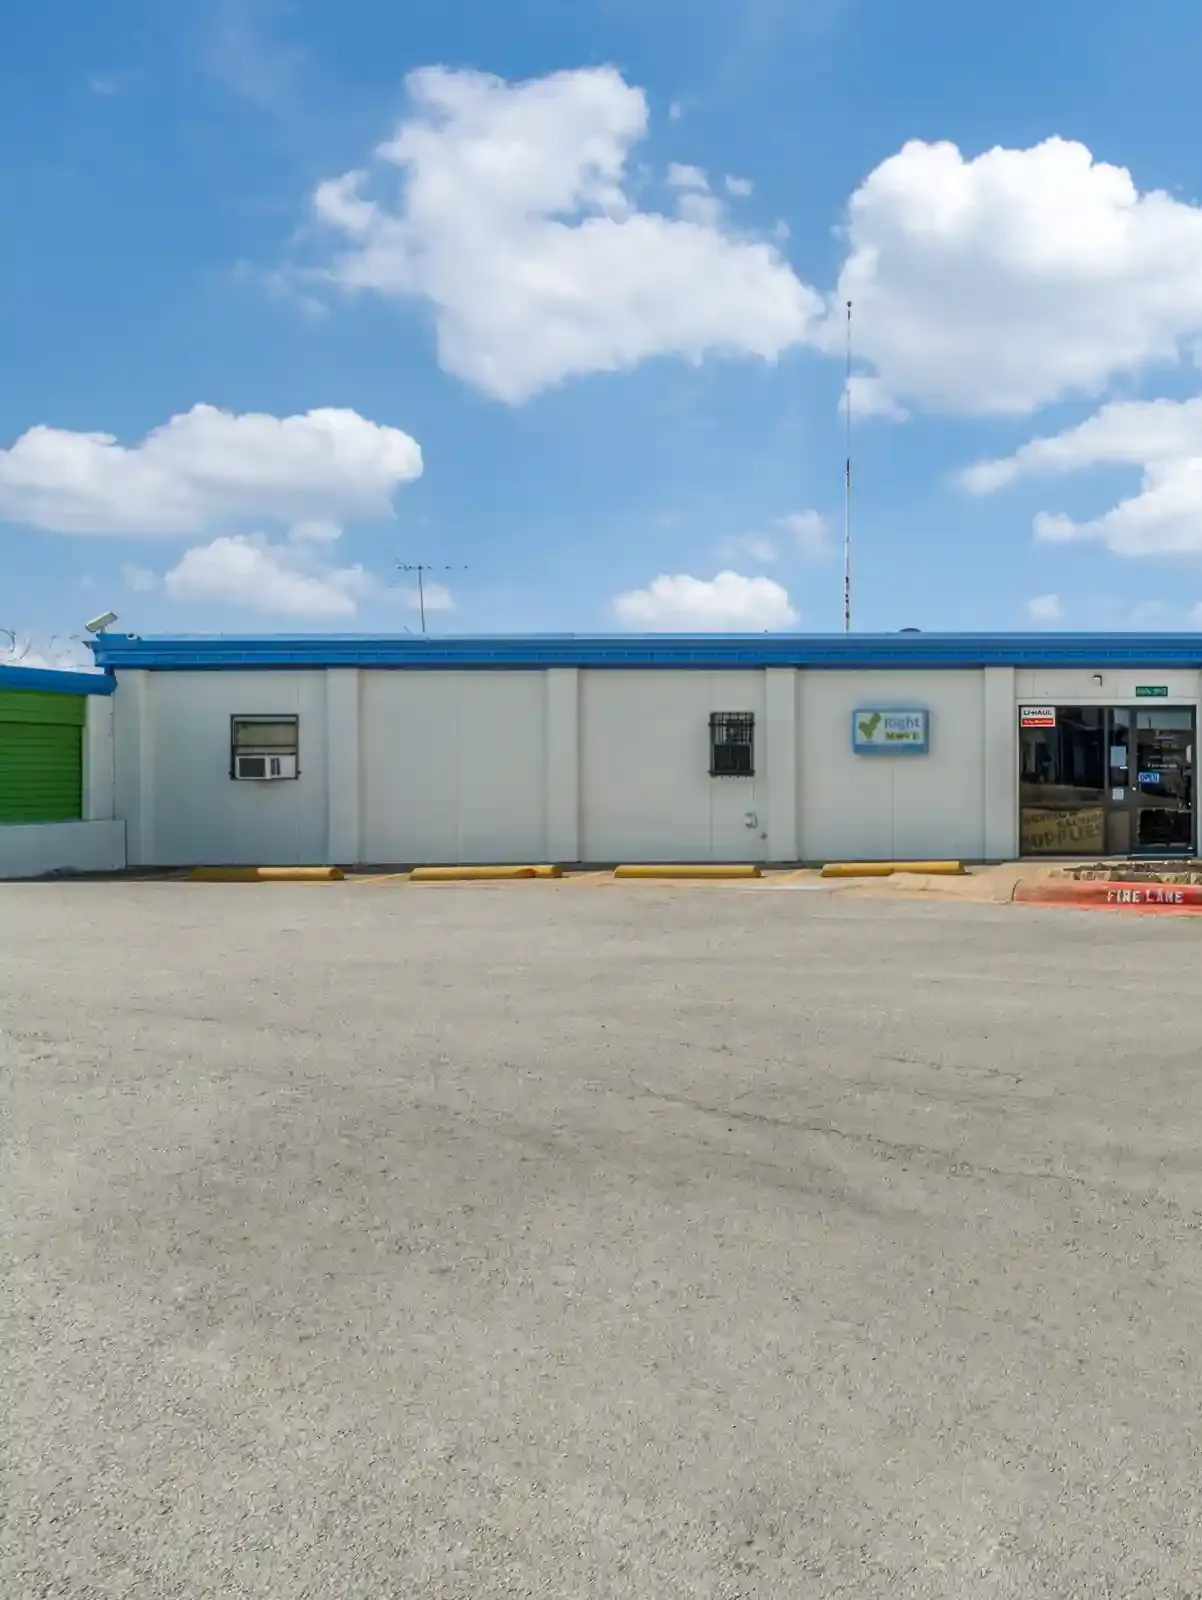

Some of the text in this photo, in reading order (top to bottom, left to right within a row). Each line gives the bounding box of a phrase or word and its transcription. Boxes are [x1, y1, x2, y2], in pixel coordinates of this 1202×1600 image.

[884, 716, 920, 730] Right
[1107, 889, 1184, 903] FIRE LANE
